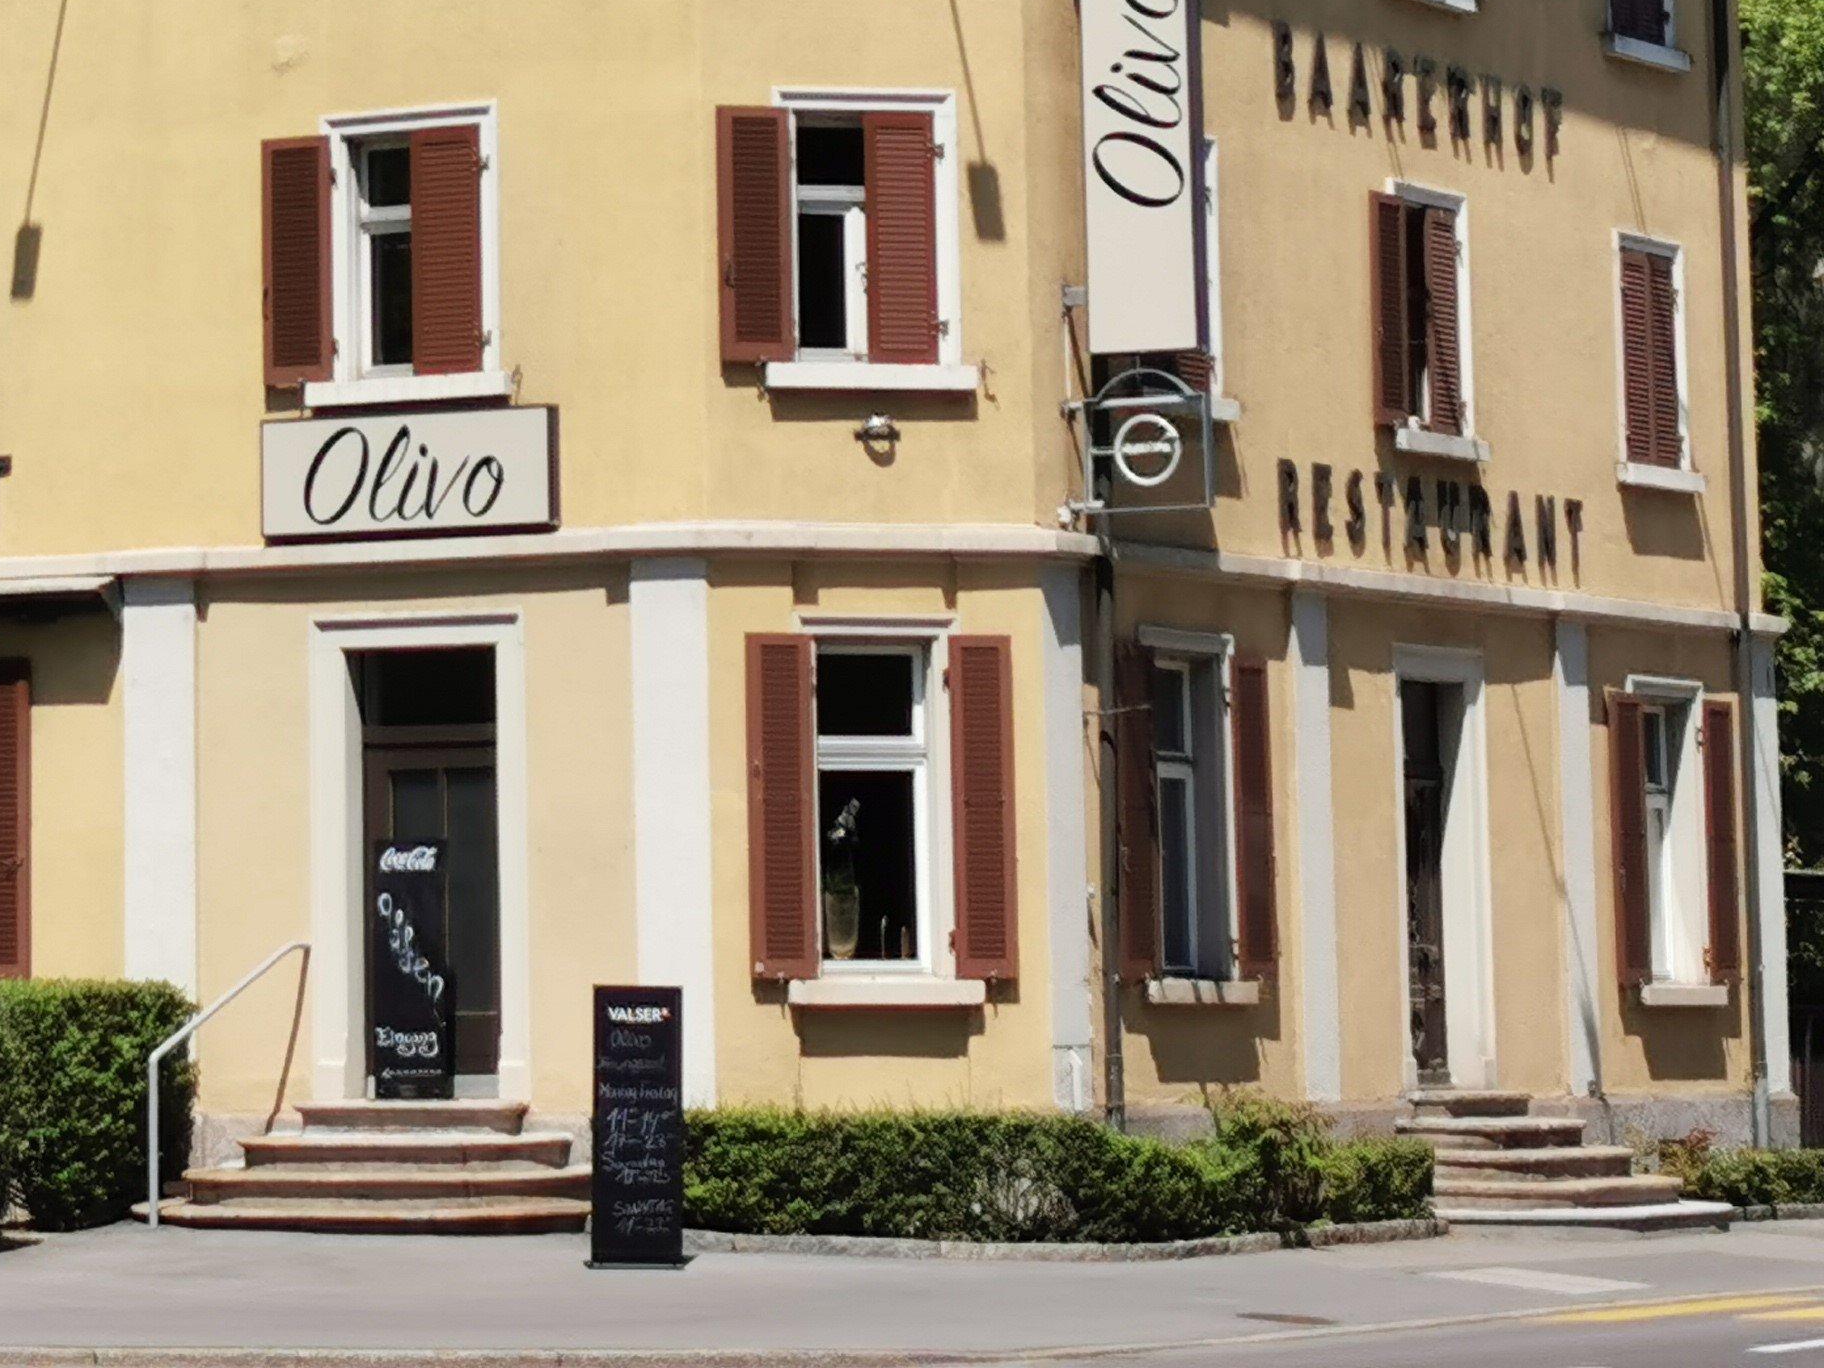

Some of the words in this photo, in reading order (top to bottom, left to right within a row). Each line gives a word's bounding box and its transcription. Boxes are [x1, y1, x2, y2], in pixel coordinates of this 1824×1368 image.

[1270, 16, 1565, 158] BAARERHOF
[303, 424, 504, 525] Olivo
[1276, 456, 1584, 582] RESTAURANT
[607, 1006, 663, 1024] VALSER
